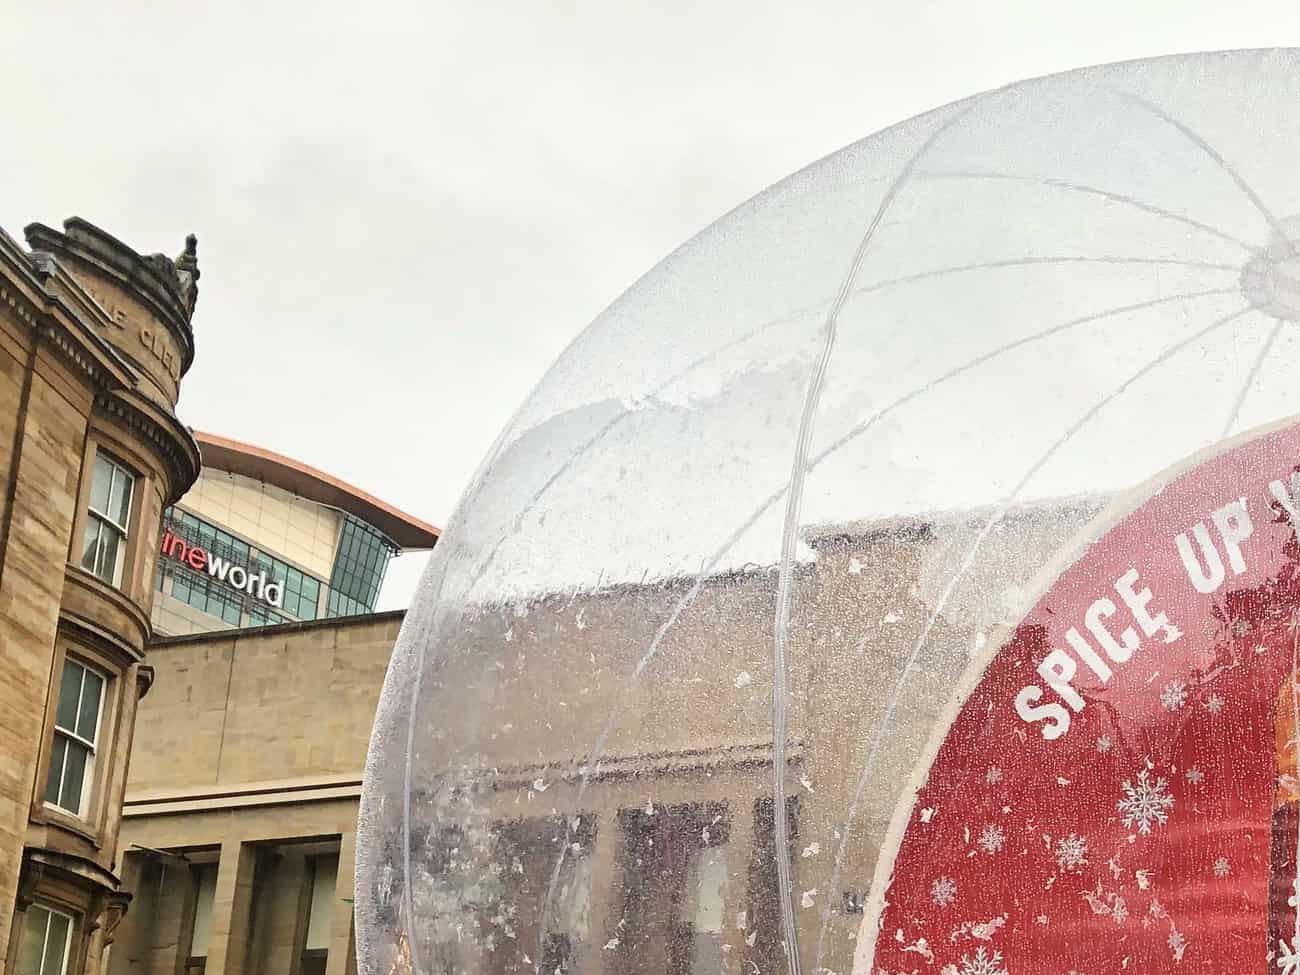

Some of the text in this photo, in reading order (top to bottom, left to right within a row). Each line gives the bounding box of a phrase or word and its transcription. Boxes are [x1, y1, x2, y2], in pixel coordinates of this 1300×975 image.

[161, 528, 284, 607] ineworld
[1014, 567, 1178, 741] SPICE
[1174, 497, 1253, 594] UP
